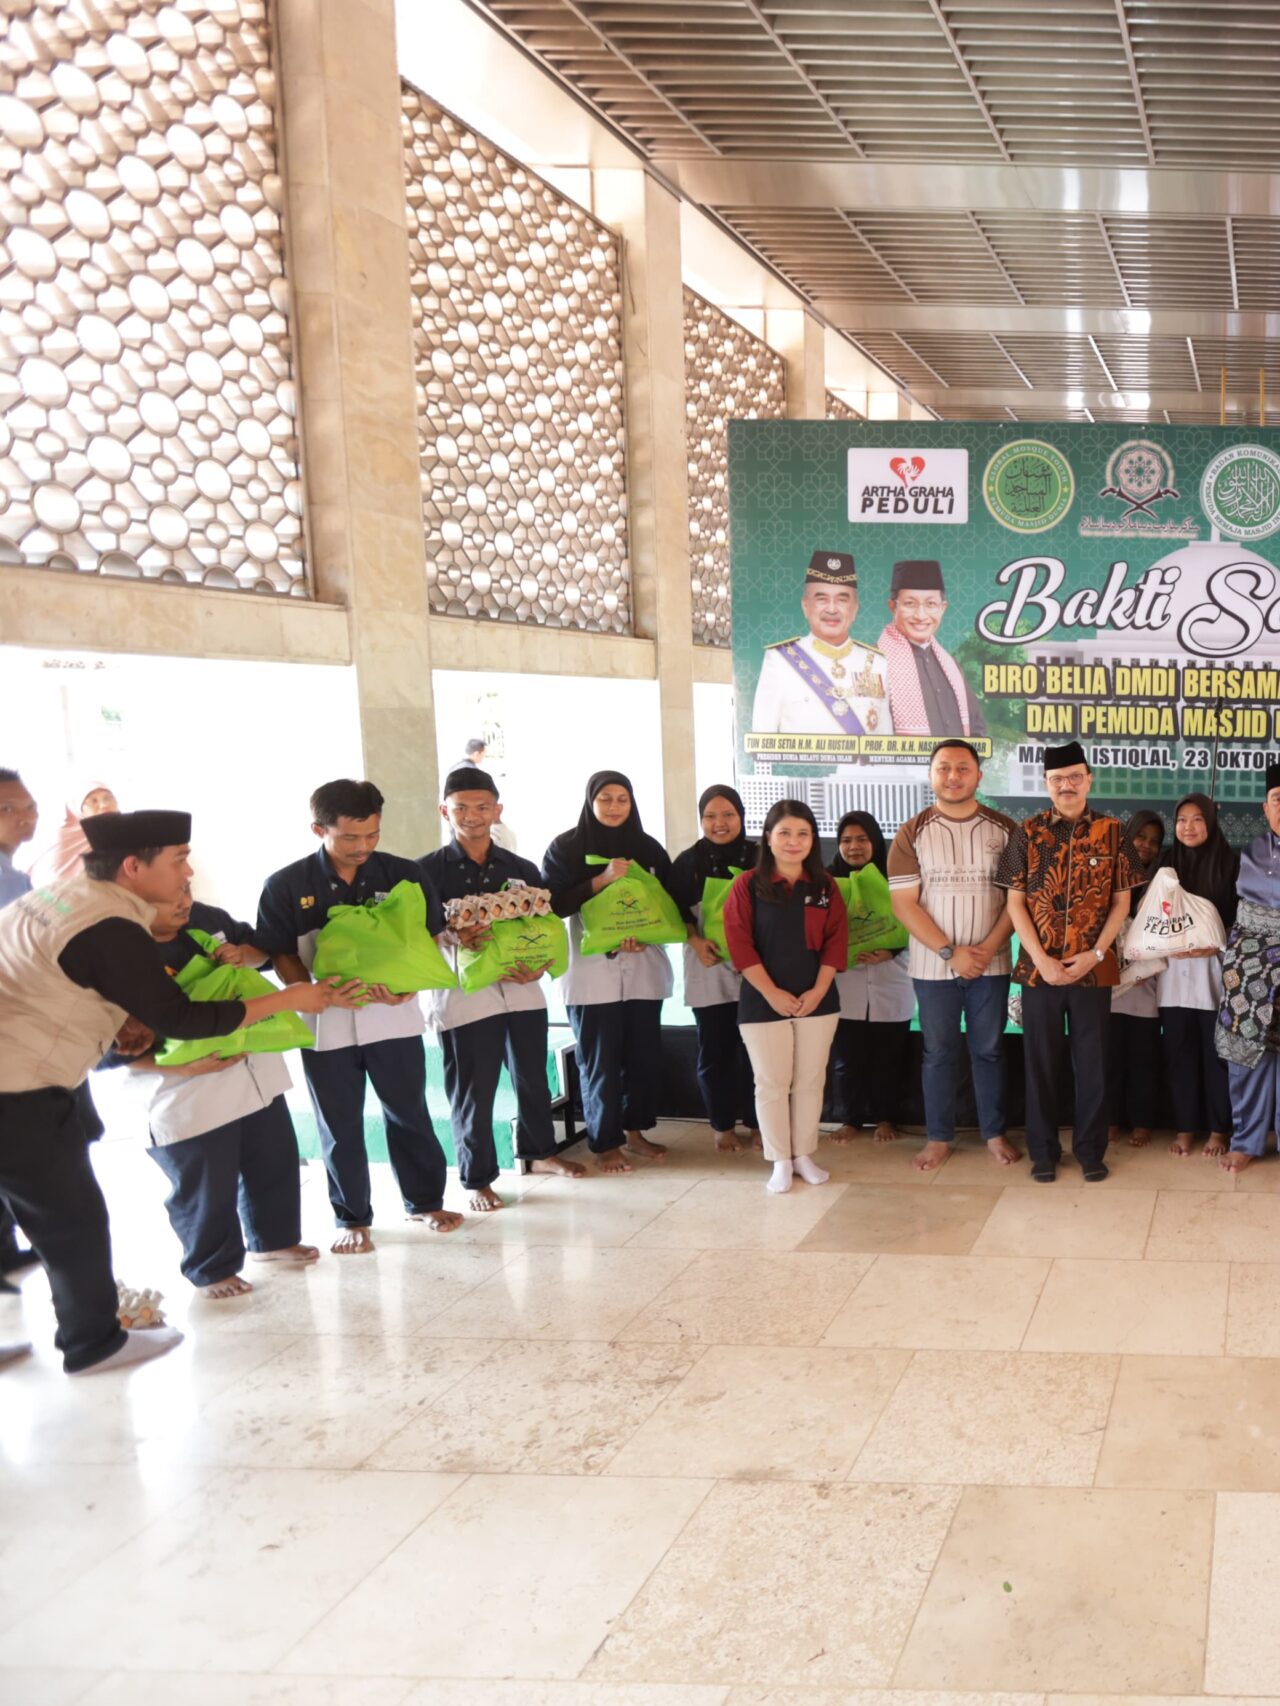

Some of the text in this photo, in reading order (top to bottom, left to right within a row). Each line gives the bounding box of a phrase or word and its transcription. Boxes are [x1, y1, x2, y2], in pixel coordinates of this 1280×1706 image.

[1012, 445, 1048, 456] MOSQUE
[1211, 452, 1236, 475] BADAN
[861, 485, 955, 498] ARTHA GRAHA
[860, 497, 955, 515] PEDULI
[1205, 481, 1217, 515] PEMUDA
[1214, 514, 1243, 535] REMAJA
[1243, 522, 1274, 537] MASJID
[975, 555, 1182, 646] Bakti
[983, 663, 1039, 694] BIRO
[1045, 664, 1109, 696] BELIA
[1114, 666, 1177, 698] DMDI
[1026, 703, 1074, 734] DAN
[1080, 705, 1176, 737] PEMUDA
[1182, 707, 1269, 739] MASJID
[747, 737, 760, 749] TUN
[761, 738, 776, 750] SERI
[778, 738, 796, 750] SETIA
[816, 739, 828, 751] ALI
[828, 739, 857, 751] RUSTAM
[864, 740, 885, 752] PROF.
[887, 740, 900, 752] DR.
[901, 740, 916, 753] K.H.
[1092, 746, 1178, 768] ISTIQLAL,
[1184, 749, 1209, 768] 23
